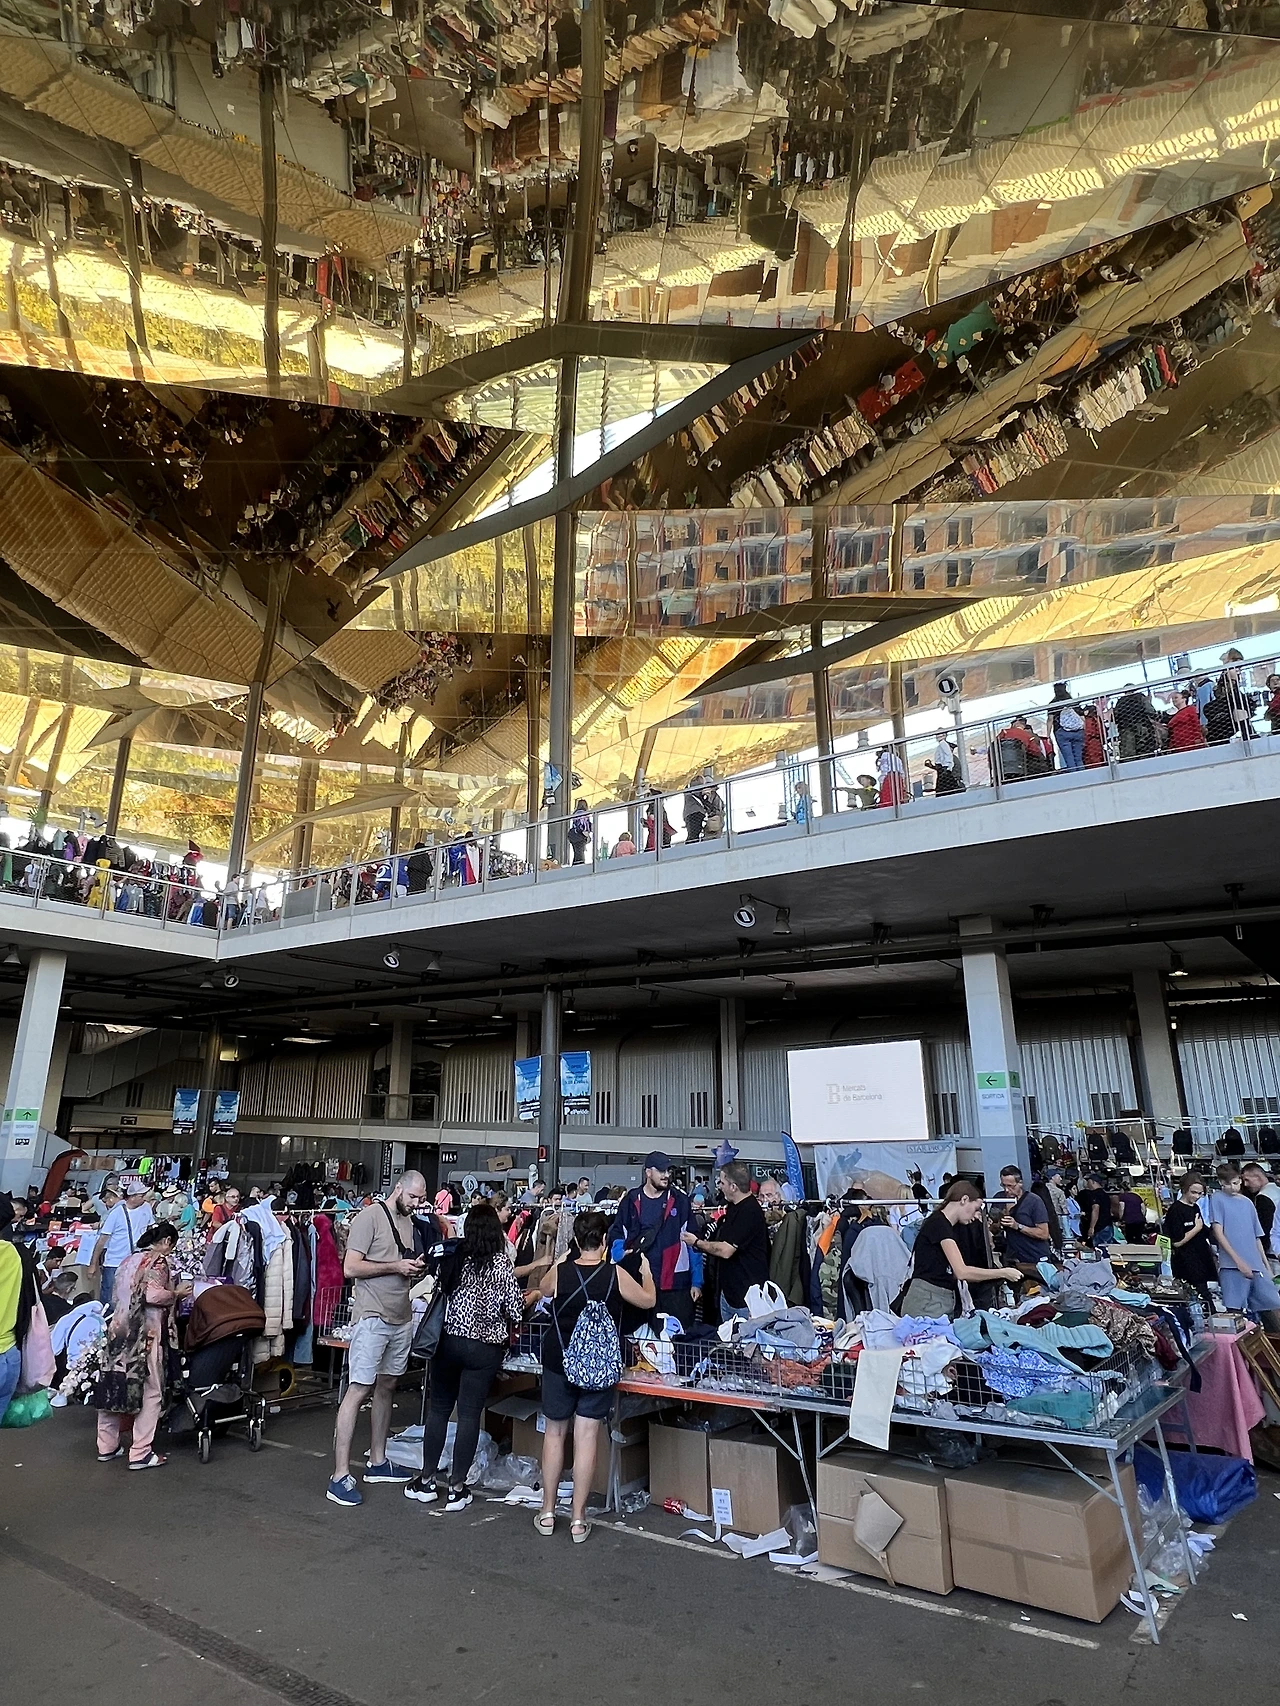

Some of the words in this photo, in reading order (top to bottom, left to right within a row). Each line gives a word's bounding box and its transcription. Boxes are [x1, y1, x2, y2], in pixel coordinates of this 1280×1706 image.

[842, 1084, 866, 1092] Mercats
[843, 1094, 852, 1102] de
[852, 1092, 883, 1101] Barcelona
